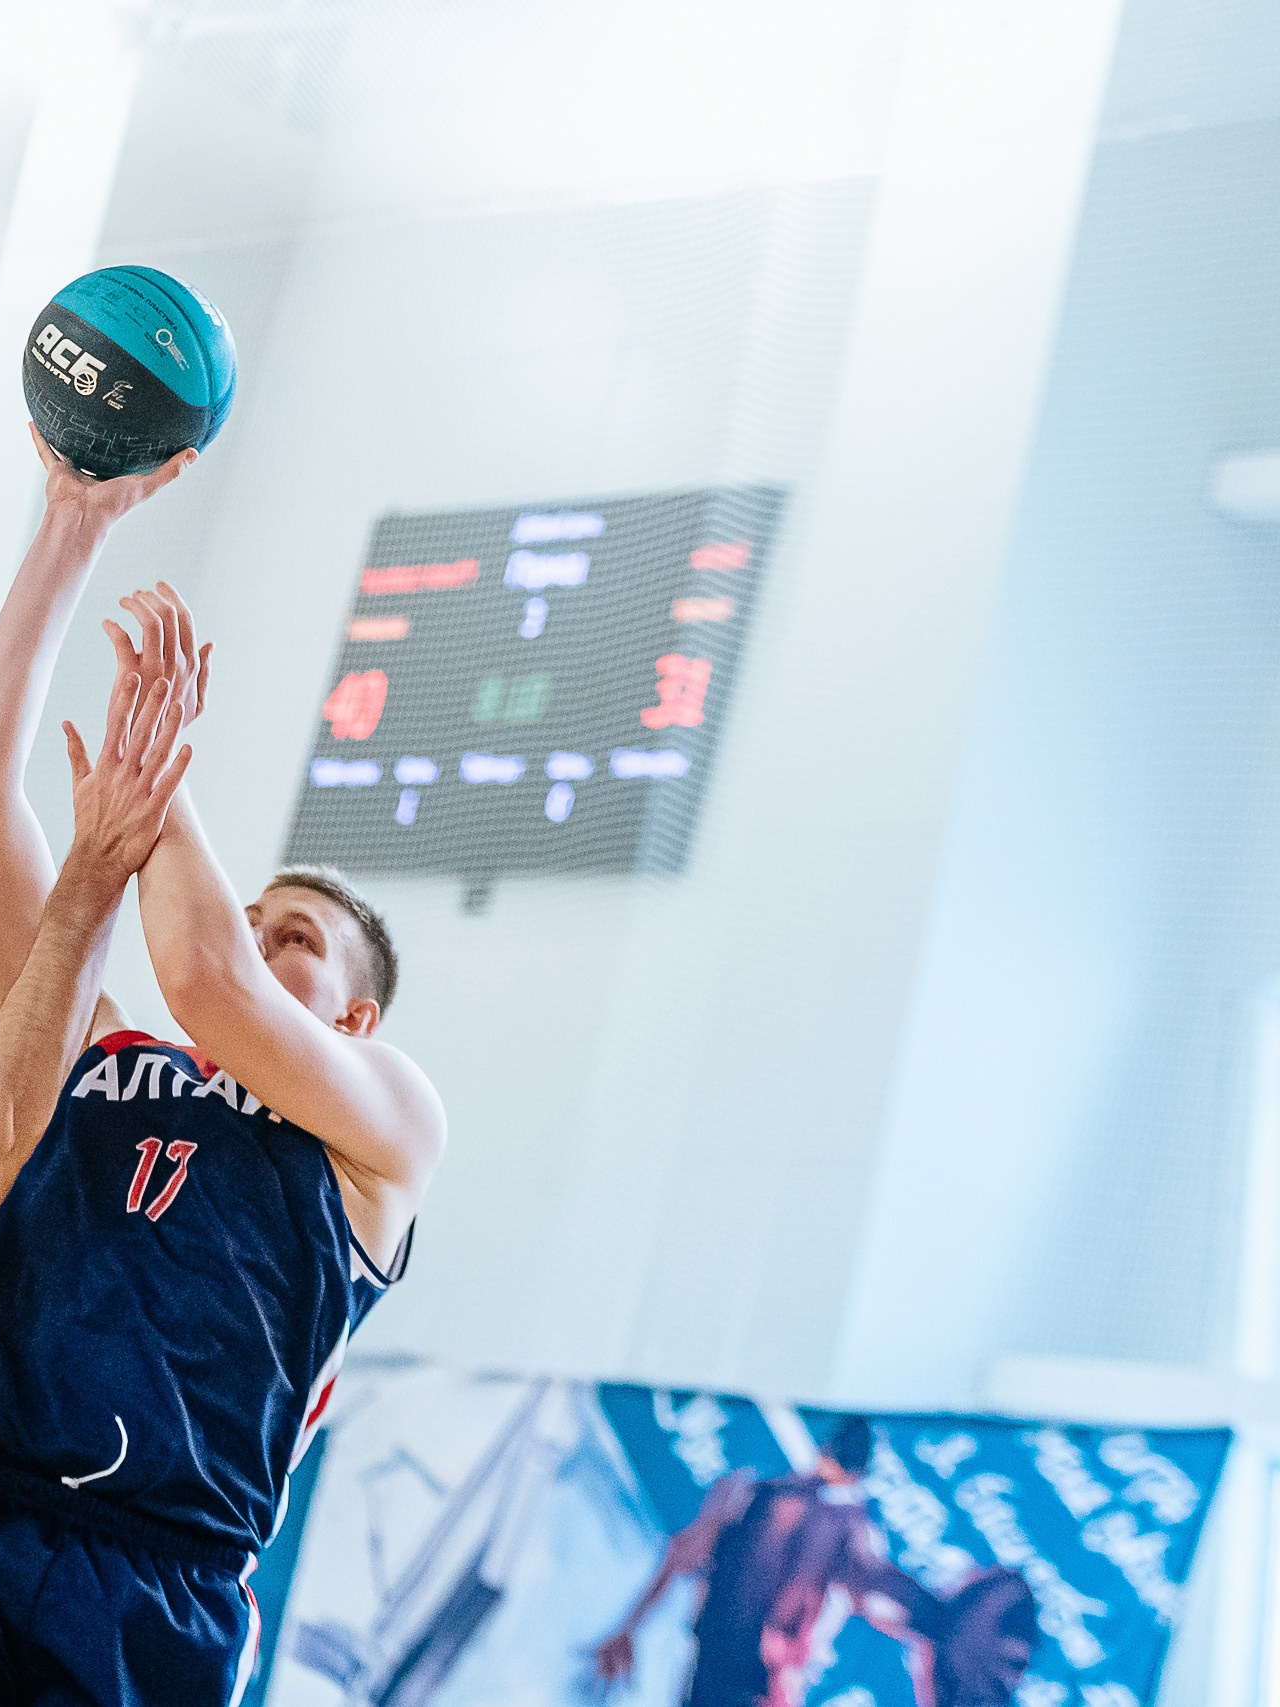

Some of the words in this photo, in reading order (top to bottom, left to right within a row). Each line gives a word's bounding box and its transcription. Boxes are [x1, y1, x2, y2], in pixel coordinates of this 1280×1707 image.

[35, 323, 108, 396] АСБ
[71, 1053, 282, 1124] АЛТА
[126, 1136, 198, 1222] 17
